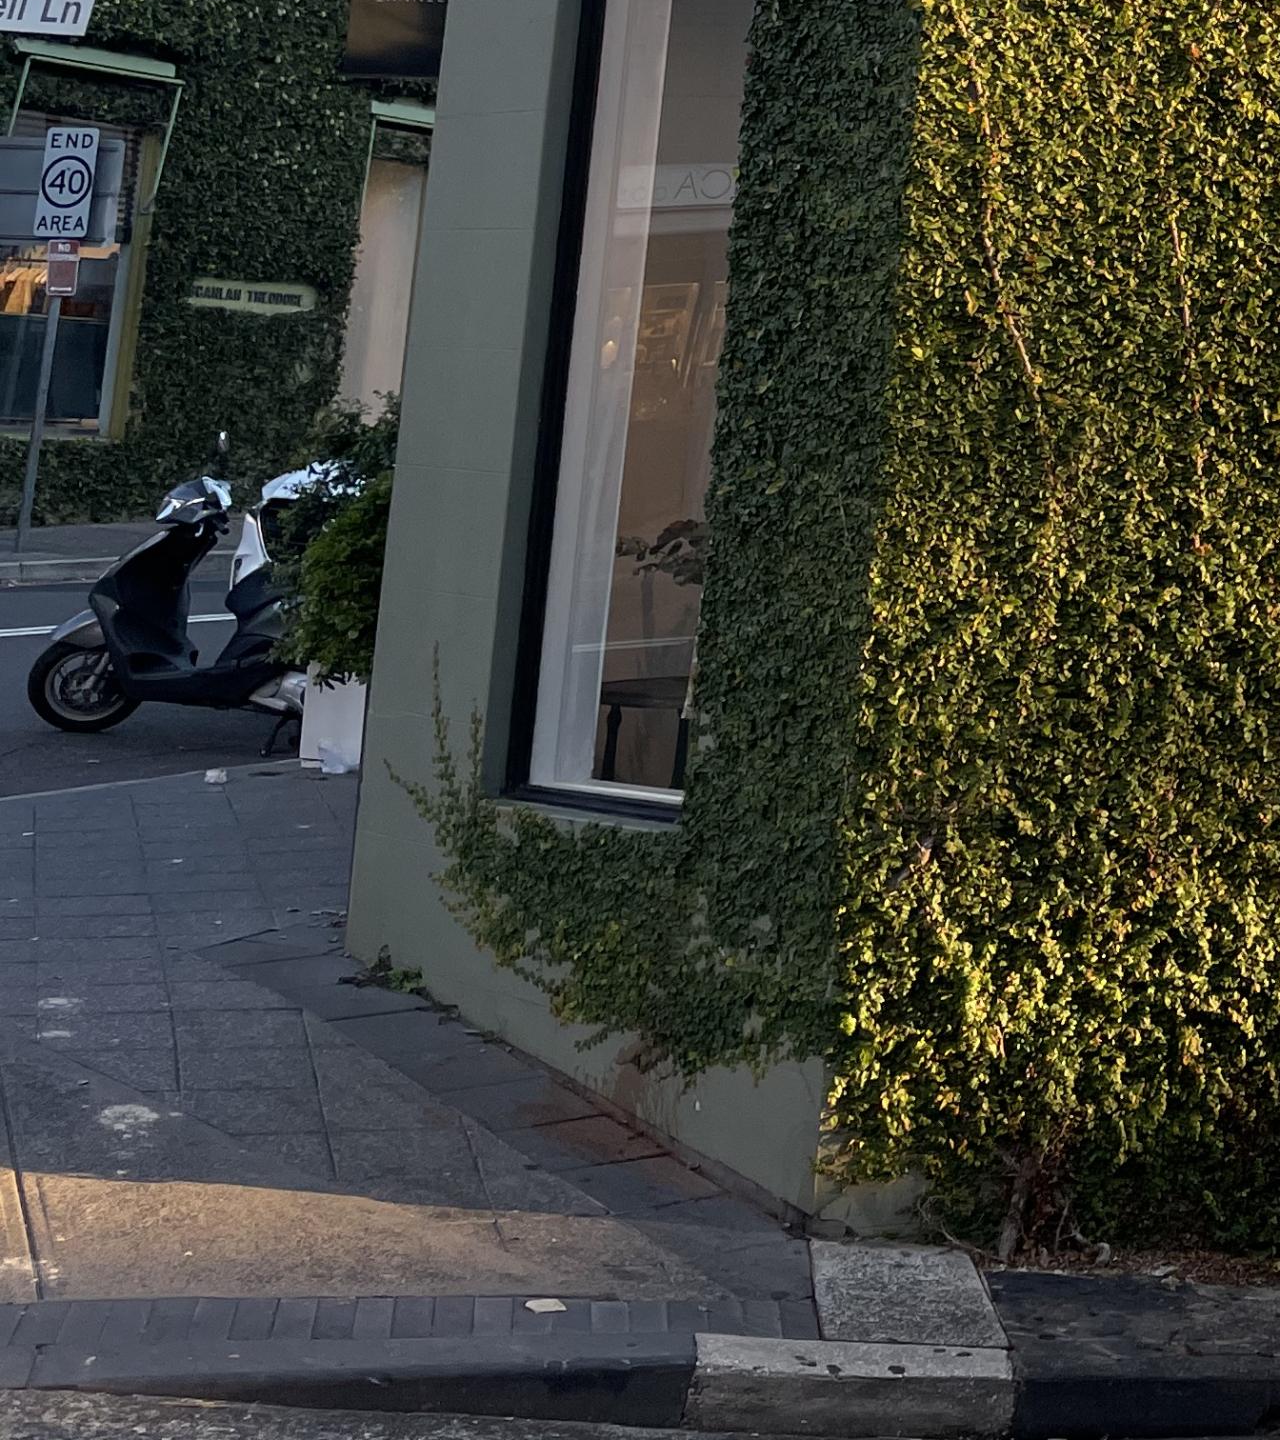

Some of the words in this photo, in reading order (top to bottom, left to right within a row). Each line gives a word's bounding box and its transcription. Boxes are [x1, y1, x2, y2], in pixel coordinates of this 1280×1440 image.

[51, 133, 94, 149] END
[48, 168, 86, 196] 40
[36, 215, 85, 232] AREA
